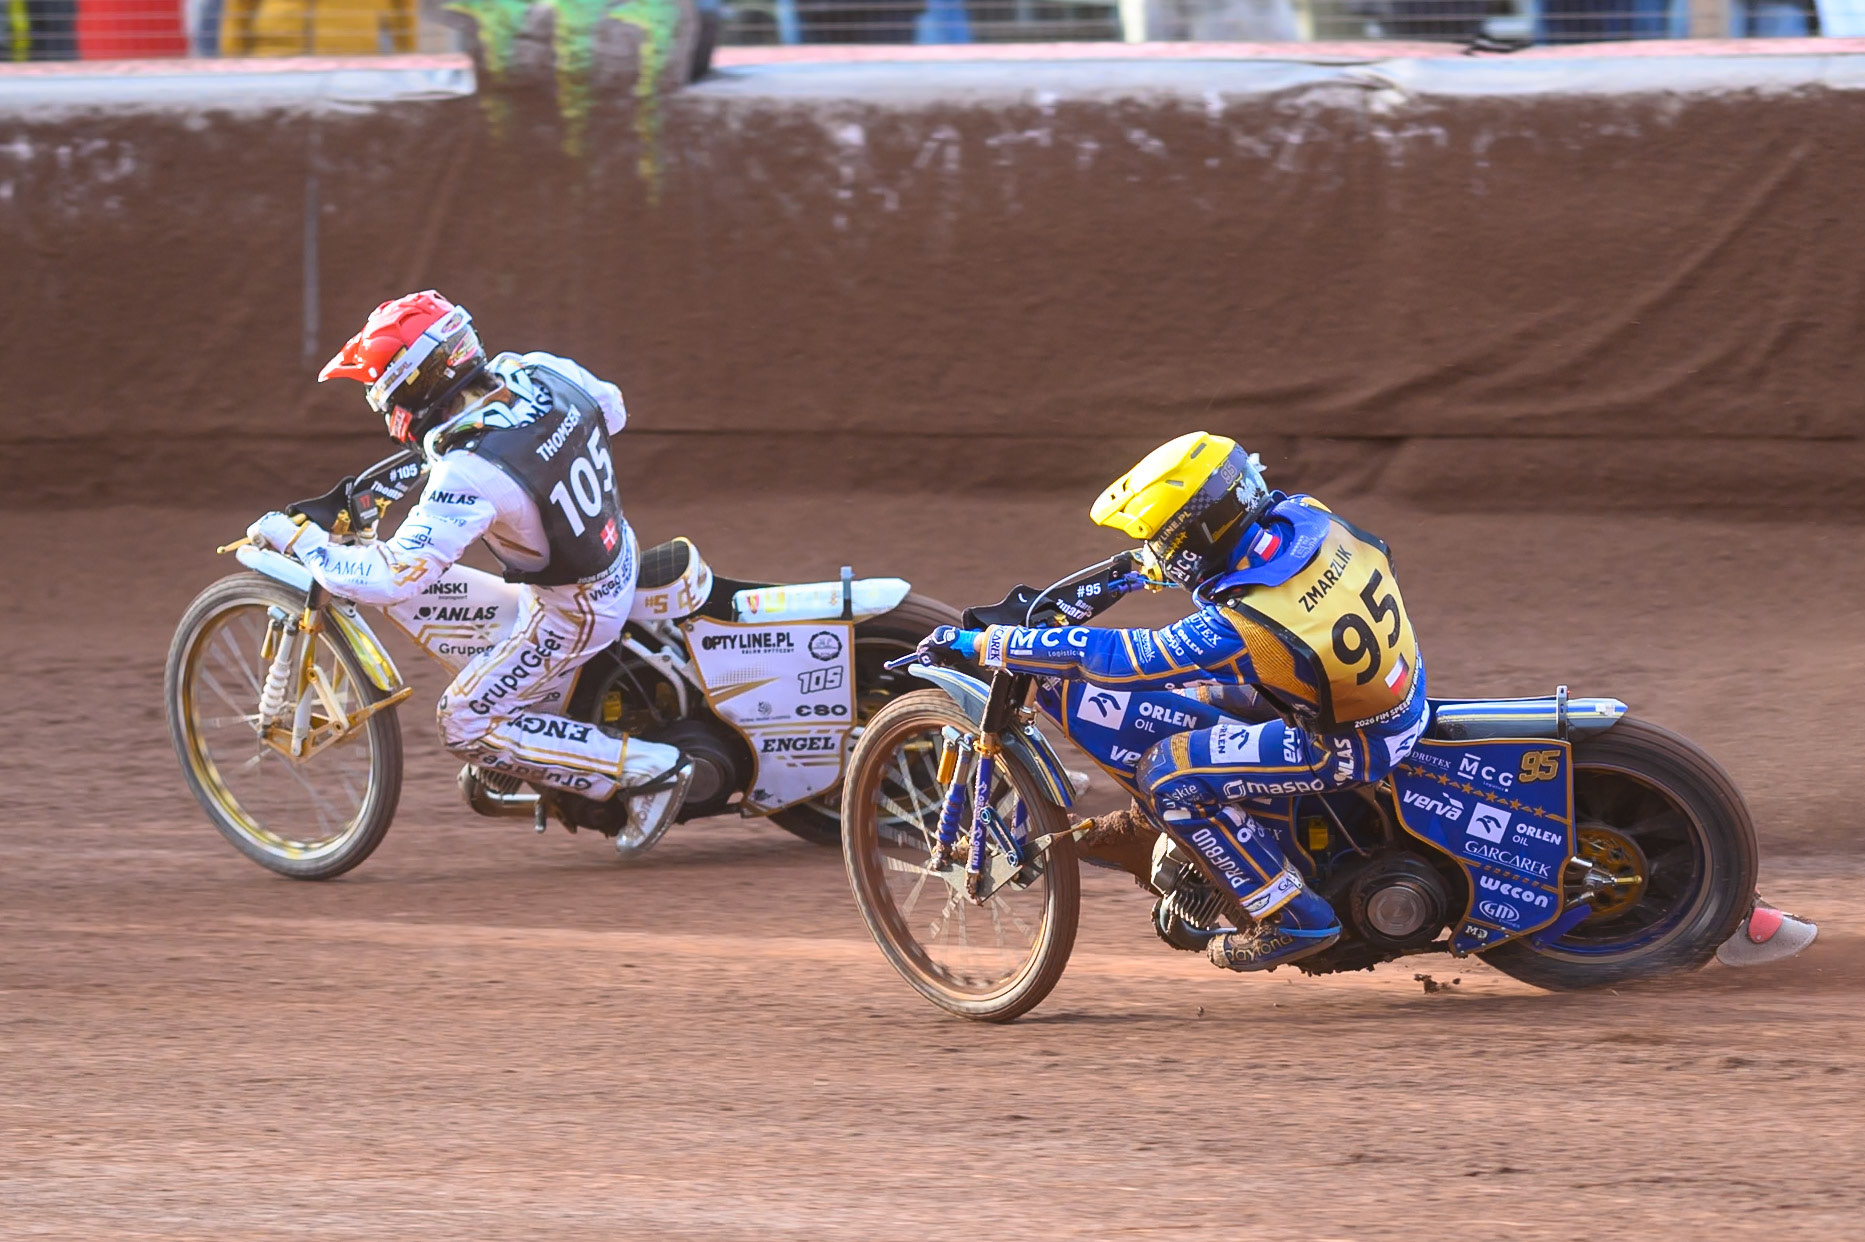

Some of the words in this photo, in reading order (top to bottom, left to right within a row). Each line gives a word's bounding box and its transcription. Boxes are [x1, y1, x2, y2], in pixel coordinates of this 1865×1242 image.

[536, 404, 581, 461] THOMSEN
[390, 463, 418, 482] #105
[549, 426, 613, 537] 105
[428, 490, 479, 505] ANLAS
[589, 575, 621, 602] VIGGO
[1077, 582, 1102, 598] #95
[1298, 544, 1352, 613] ZMARZLIK
[435, 606, 499, 621] ANLAS
[1331, 568, 1401, 686] 95
[702, 632, 794, 651] OPTYLINE.PL
[798, 665, 844, 694] 105
[1134, 719, 1156, 734] OIL
[1139, 702, 1197, 729] ORLEN
[1354, 717, 1375, 729] 2026
[1375, 711, 1390, 722] FIM
[761, 737, 836, 753] ENGEL
[1411, 750, 1452, 769] DRUTEX
[1519, 750, 1562, 783] 95
[1403, 789, 1465, 821] verva
[1512, 834, 1529, 847] OIL
[1516, 823, 1562, 846] ORLEN
[1464, 840, 1552, 877] GARCAREK
[1480, 875, 1549, 908] wecon
